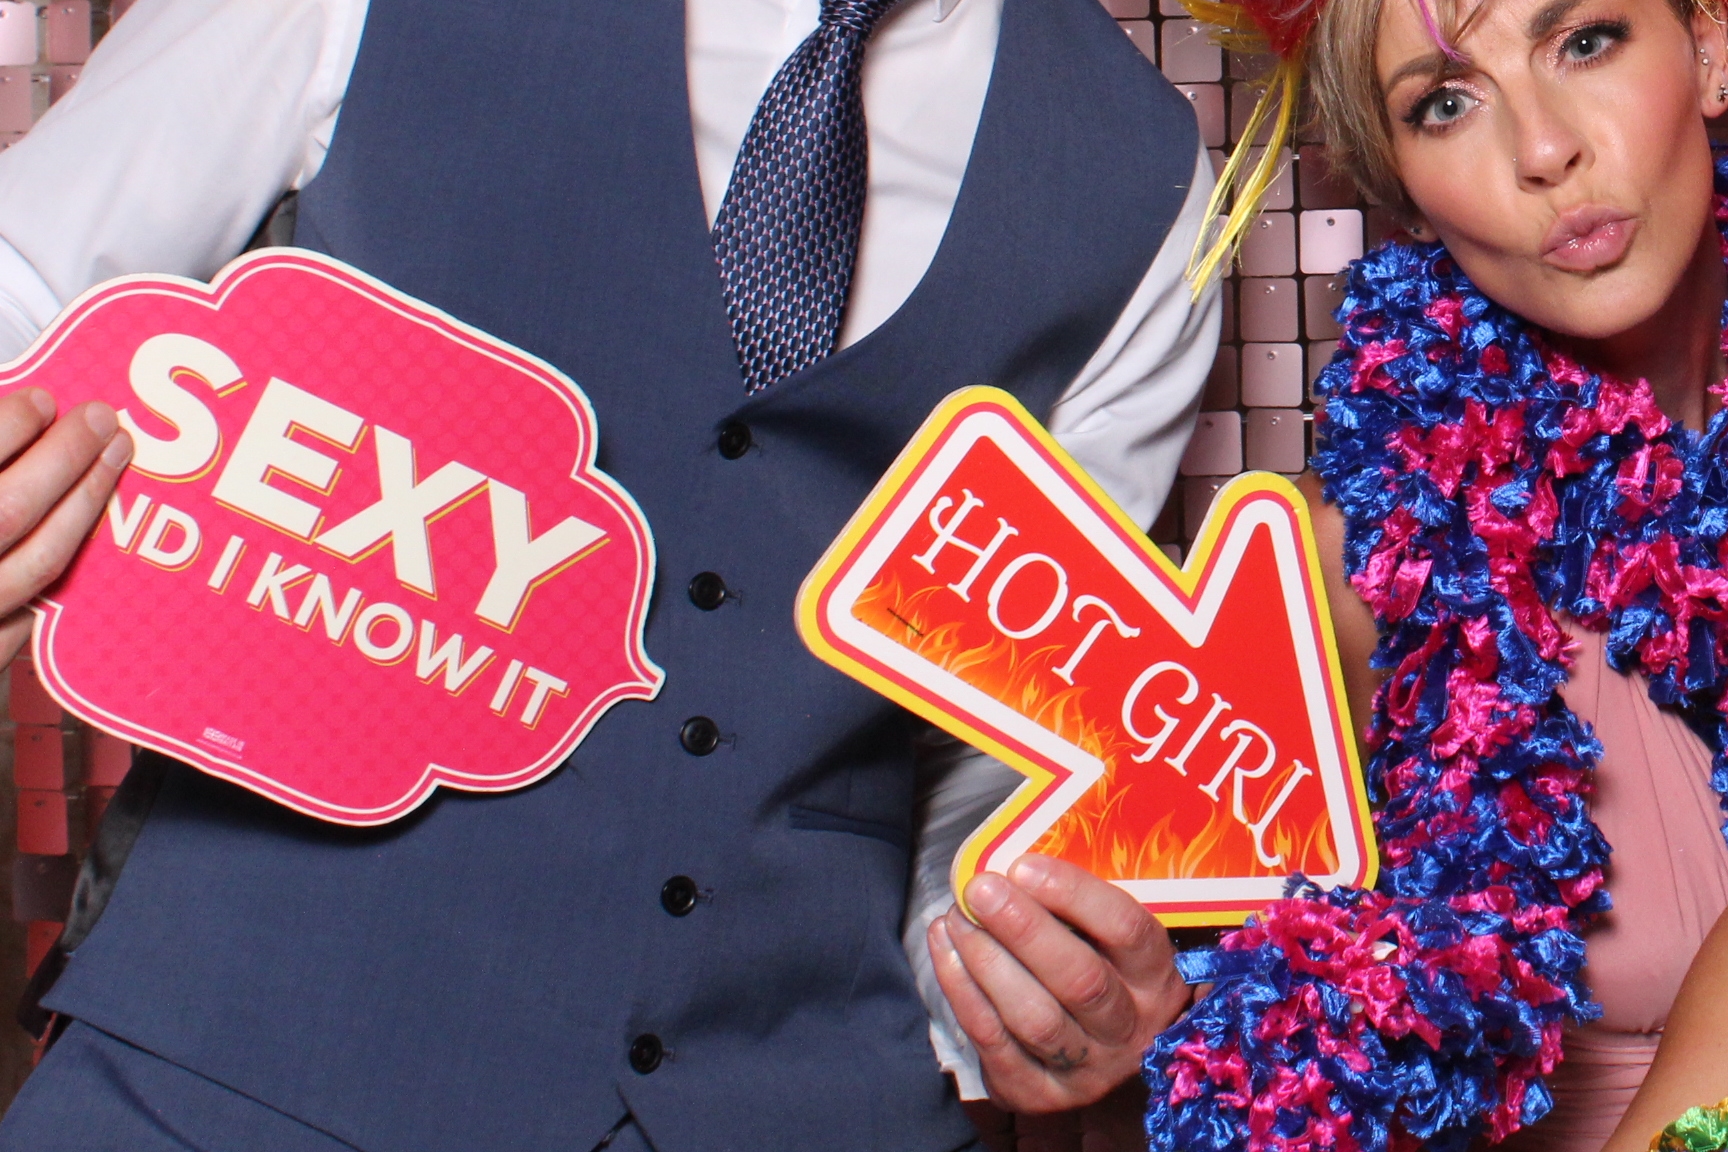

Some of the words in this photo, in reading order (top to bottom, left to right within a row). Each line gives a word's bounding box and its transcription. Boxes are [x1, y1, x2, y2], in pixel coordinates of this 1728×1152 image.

[93, 492, 203, 573] ND
[207, 534, 248, 595] I
[246, 551, 496, 698] KNOW
[489, 659, 570, 730] IT
[117, 332, 610, 634] SEXY
[911, 488, 1141, 686] HOT
[1120, 660, 1314, 867] GIRL
